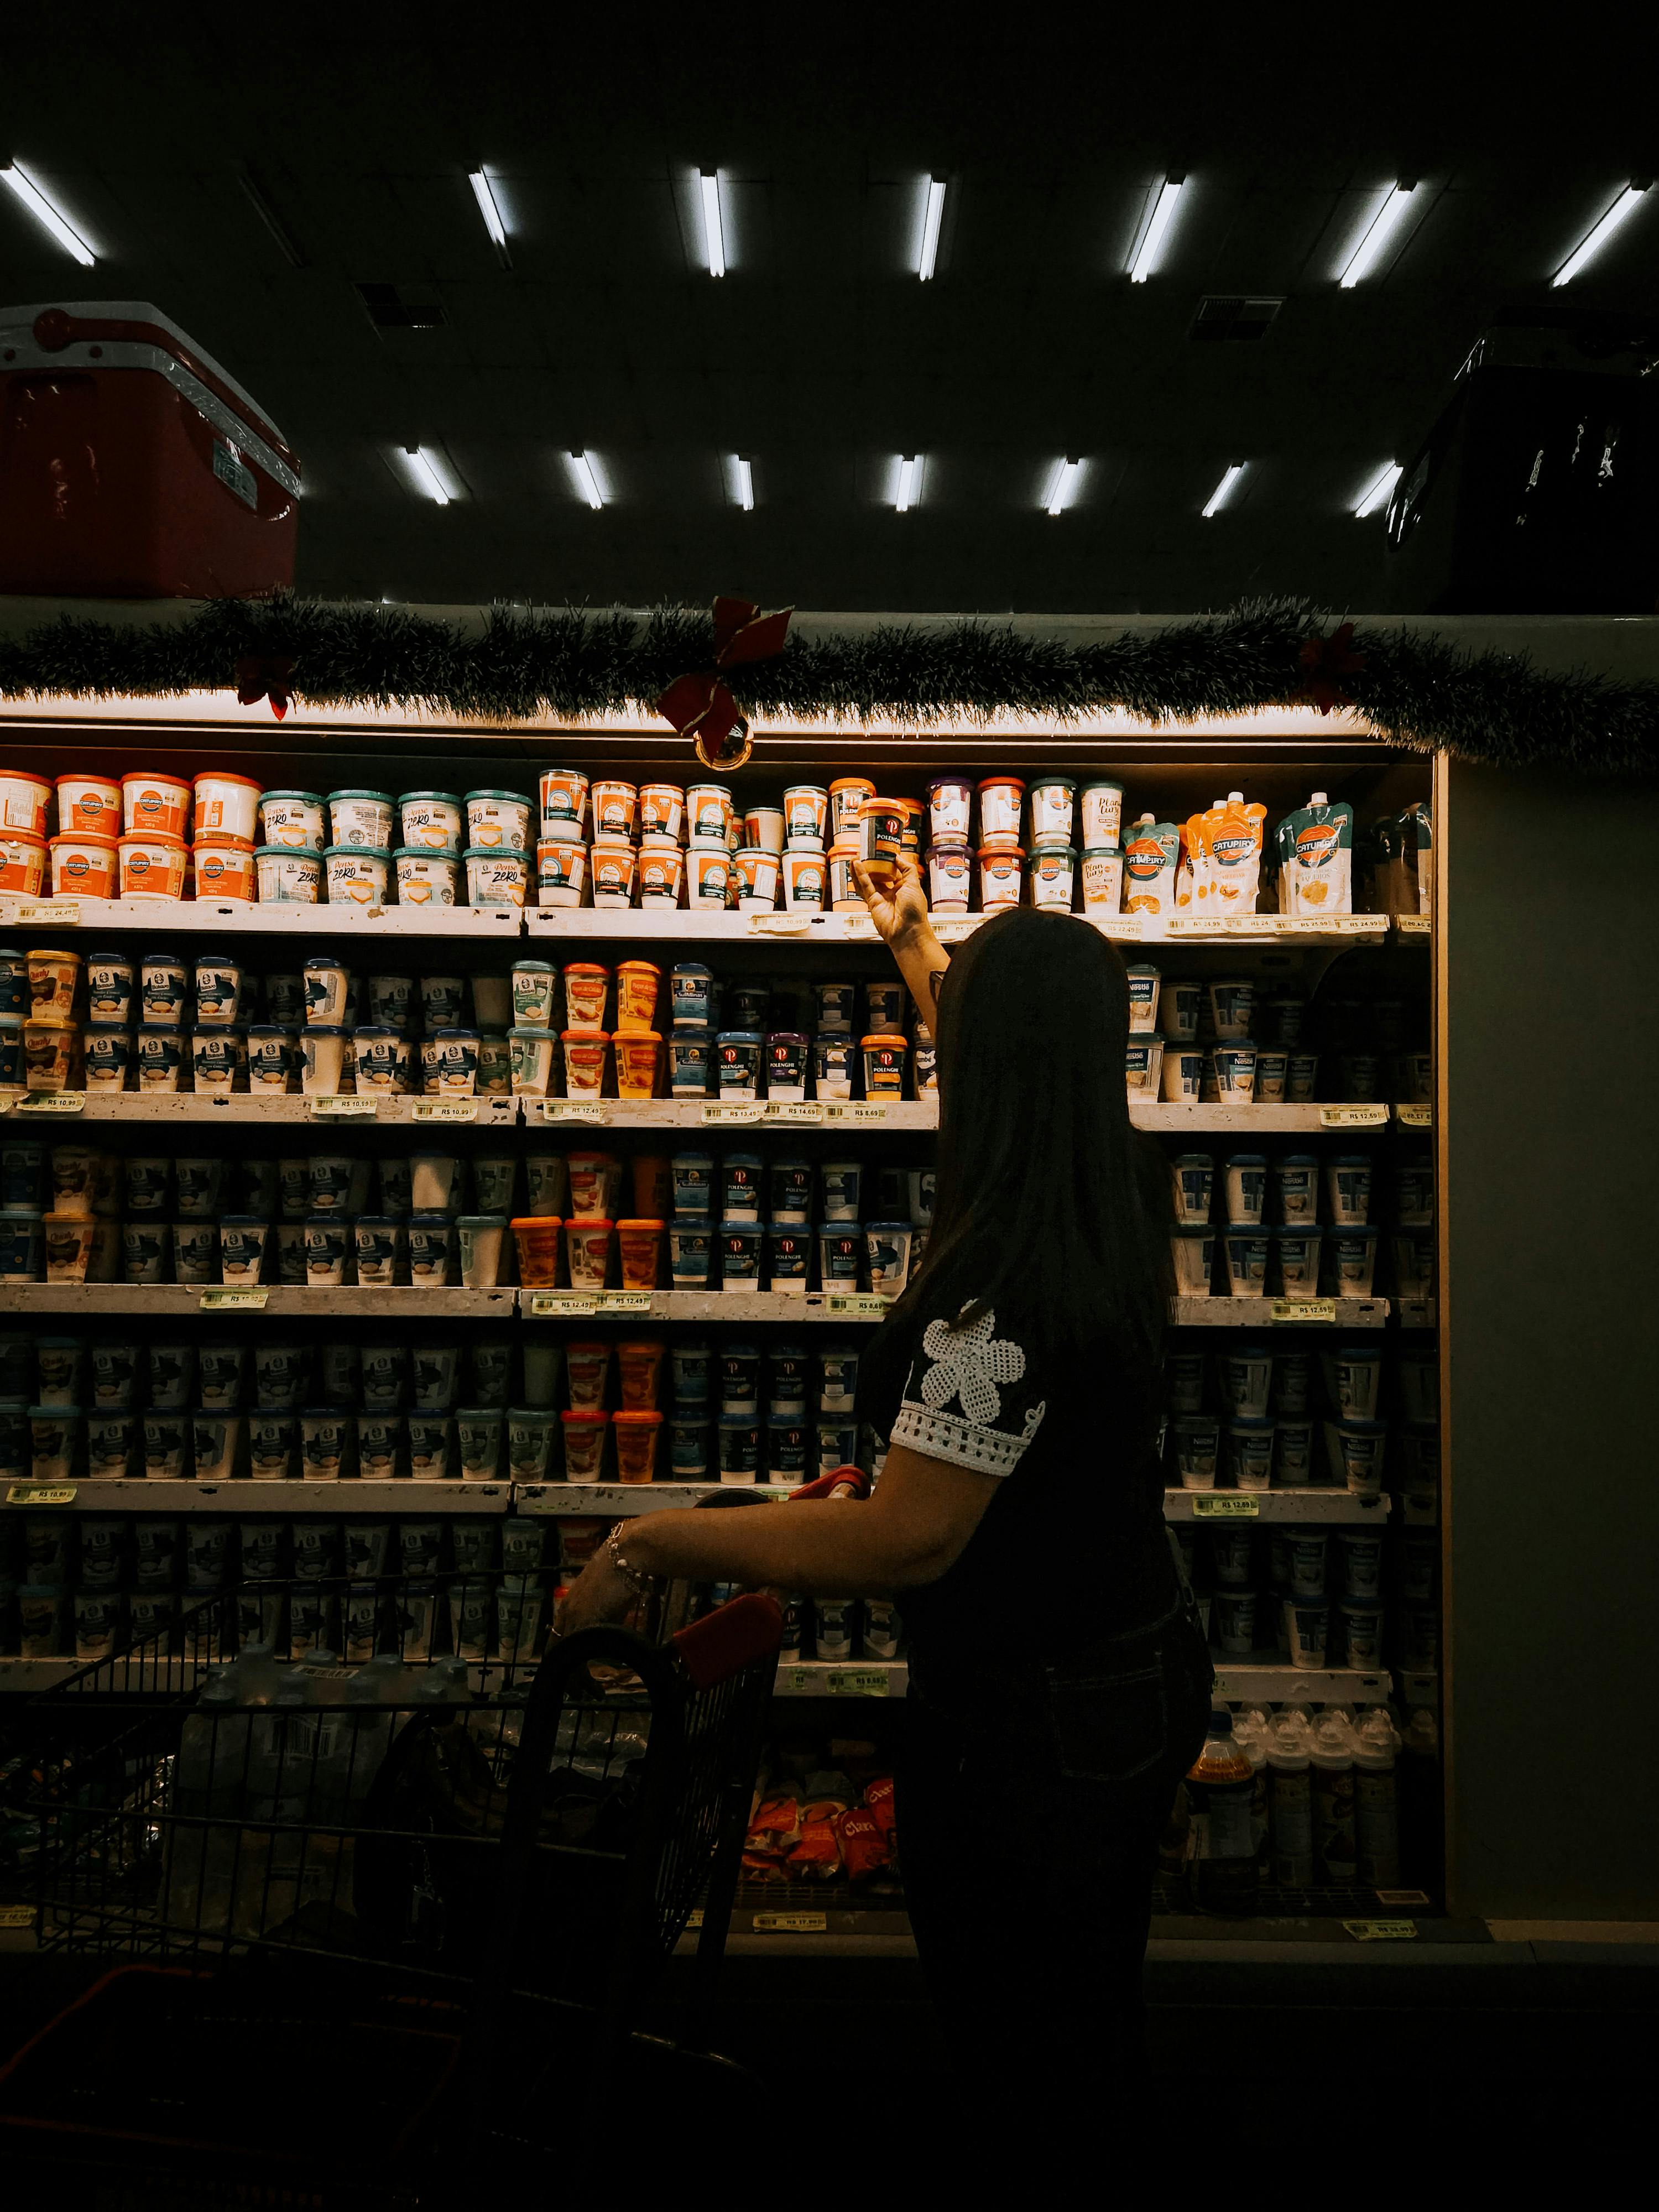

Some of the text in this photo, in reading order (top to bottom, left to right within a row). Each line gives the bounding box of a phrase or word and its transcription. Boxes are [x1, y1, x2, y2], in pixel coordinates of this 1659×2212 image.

[1213, 839, 1255, 852] CATUPIRY
[1297, 839, 1337, 852] CATUPIRY
[845, 1820, 876, 1837] Clara
